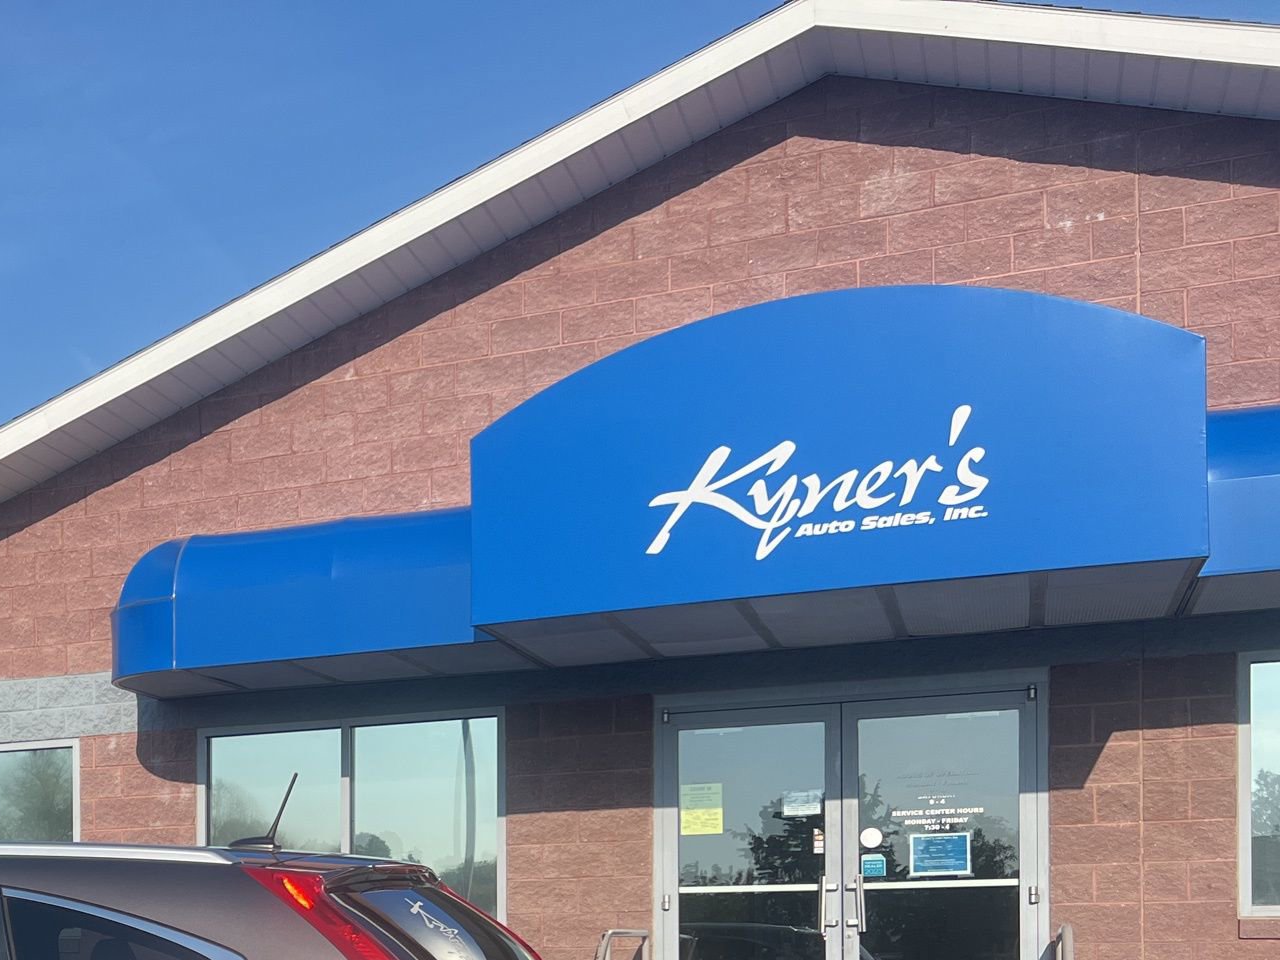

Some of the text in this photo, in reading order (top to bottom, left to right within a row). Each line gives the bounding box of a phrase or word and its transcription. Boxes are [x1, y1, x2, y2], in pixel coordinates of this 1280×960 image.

[645, 404, 990, 561] Kyner's
[794, 505, 989, 538] Auto Sales, Inc.
[925, 808, 956, 816] CENTER
[941, 816, 969, 824] FRIDAY
